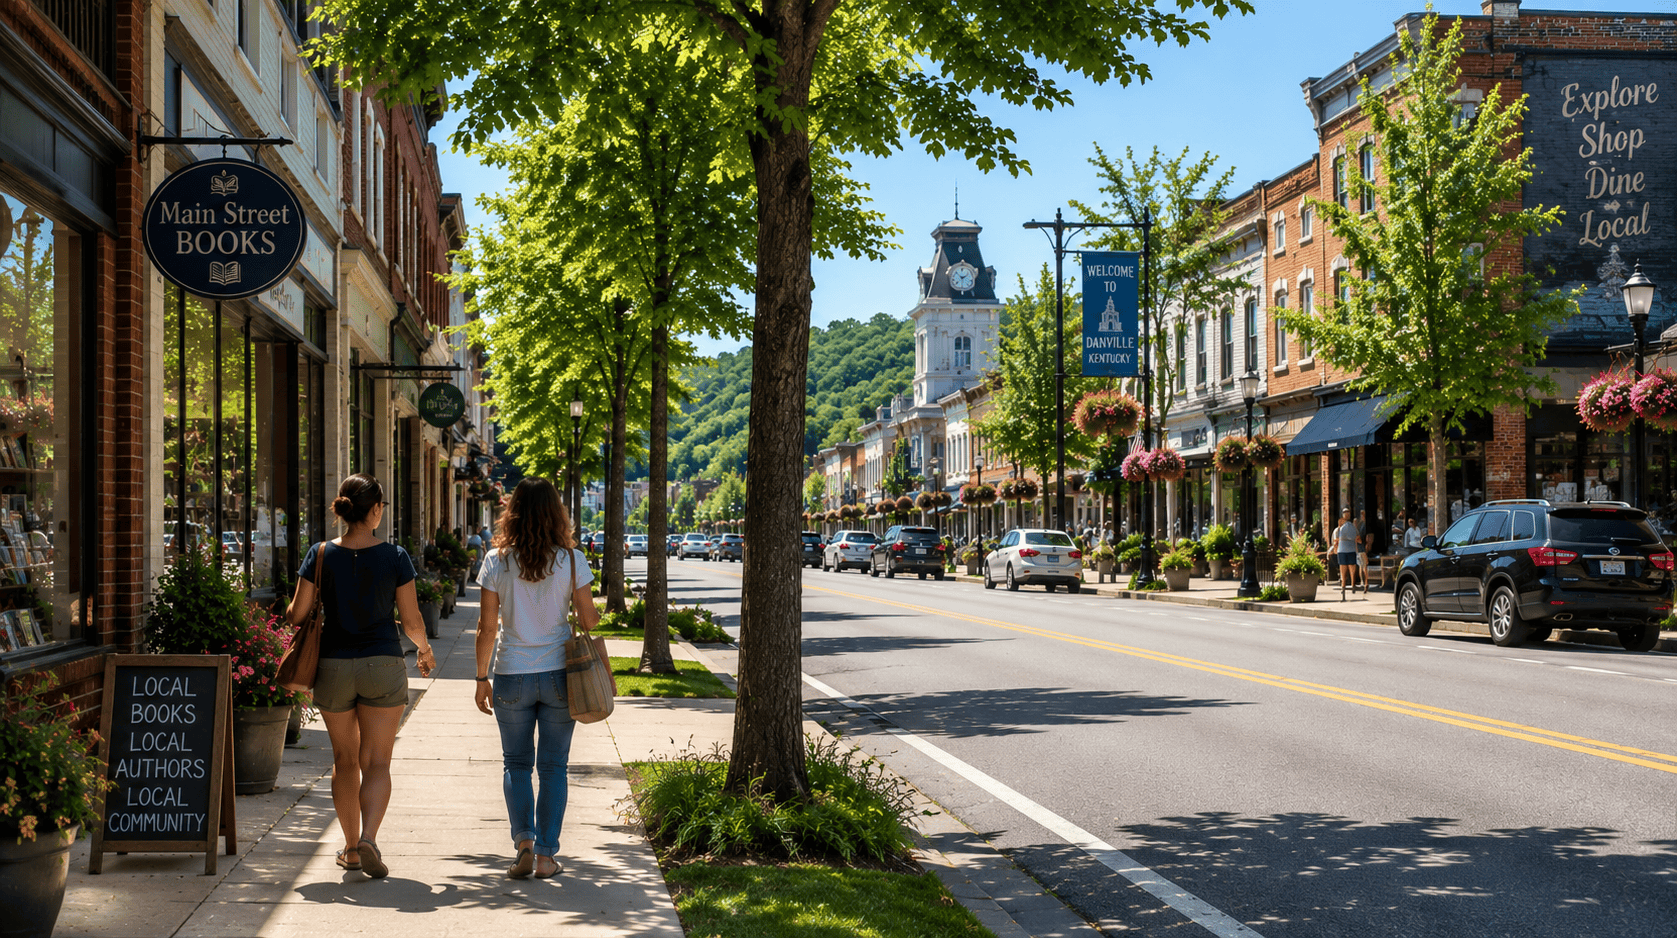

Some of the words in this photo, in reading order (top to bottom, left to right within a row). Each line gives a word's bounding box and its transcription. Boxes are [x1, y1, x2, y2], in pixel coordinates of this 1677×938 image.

[1561, 75, 1660, 120] Explore
[1579, 121, 1646, 160] Shop
[1585, 166, 1646, 199] Dine
[159, 201, 217, 224] Main
[223, 201, 290, 225] Street
[1579, 201, 1651, 247] Local
[176, 230, 276, 255] BOOKS
[1086, 265, 1134, 278] WELCOME
[1104, 281, 1117, 292] TO
[1086, 337, 1134, 348] DANVILLE
[1088, 353, 1132, 363] KENTUCKY
[132, 676, 197, 697] LOCAL
[131, 703, 196, 724] BOOKS
[130, 732, 192, 751] LOCAL
[115, 758, 205, 778] AUTHORS
[127, 787, 188, 806] LOCAL
[108, 812, 205, 832] COMMUNITY
